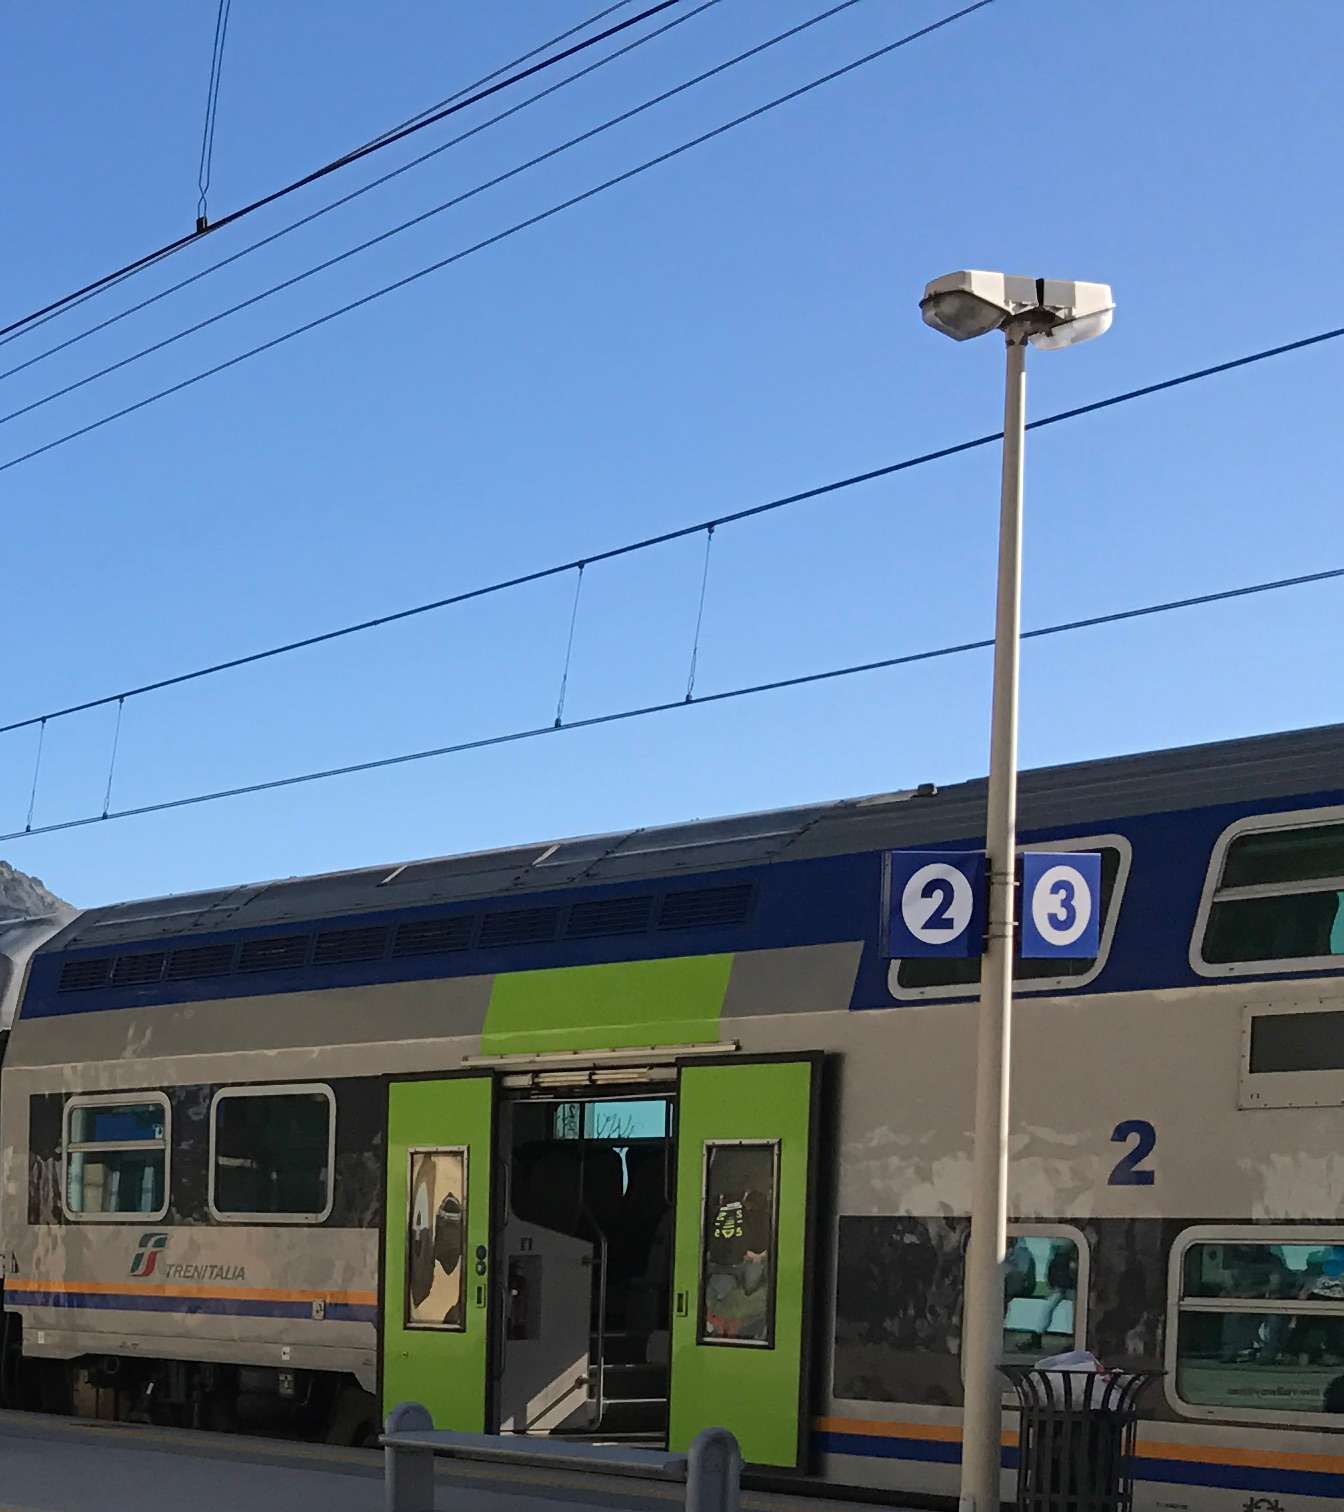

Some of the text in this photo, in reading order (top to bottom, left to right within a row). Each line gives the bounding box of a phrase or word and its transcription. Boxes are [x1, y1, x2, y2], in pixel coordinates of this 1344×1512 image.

[920, 878, 955, 930] 2
[1047, 879, 1077, 932] 3
[1107, 1119, 1157, 1186] 2
[166, 1263, 246, 1281] TRENITALIA
